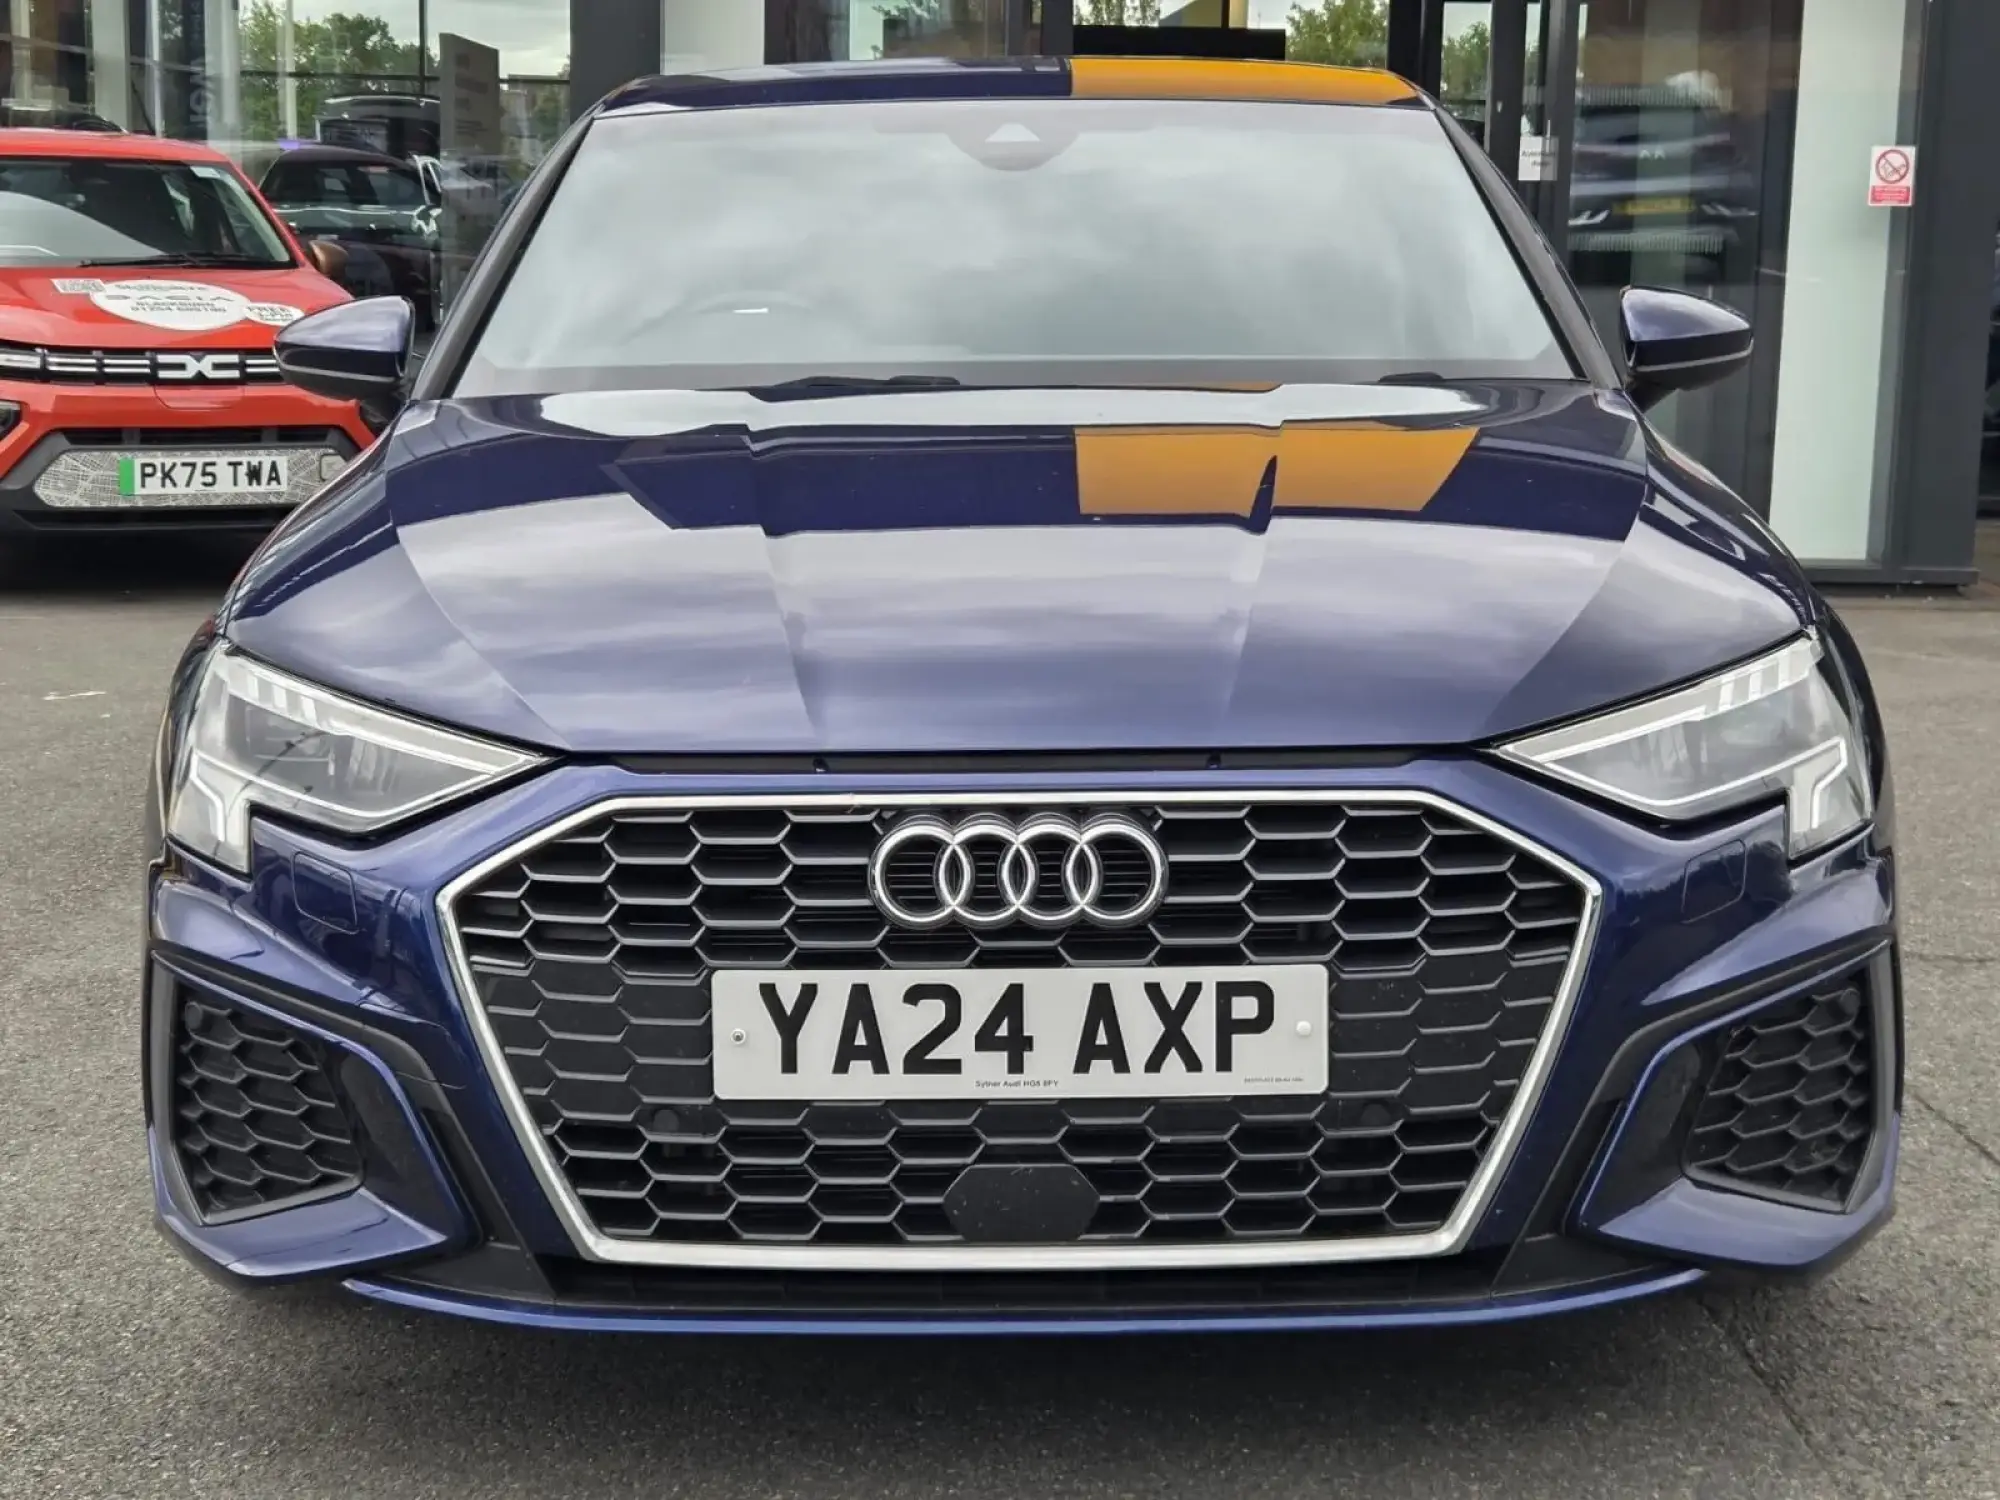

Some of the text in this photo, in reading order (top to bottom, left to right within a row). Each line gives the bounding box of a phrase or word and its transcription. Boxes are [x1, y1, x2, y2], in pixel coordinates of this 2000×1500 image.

[105, 294, 235, 302] DACIA
[140, 460, 281, 488] PK75 TWA
[758, 980, 1275, 1075] YA24 AXP
